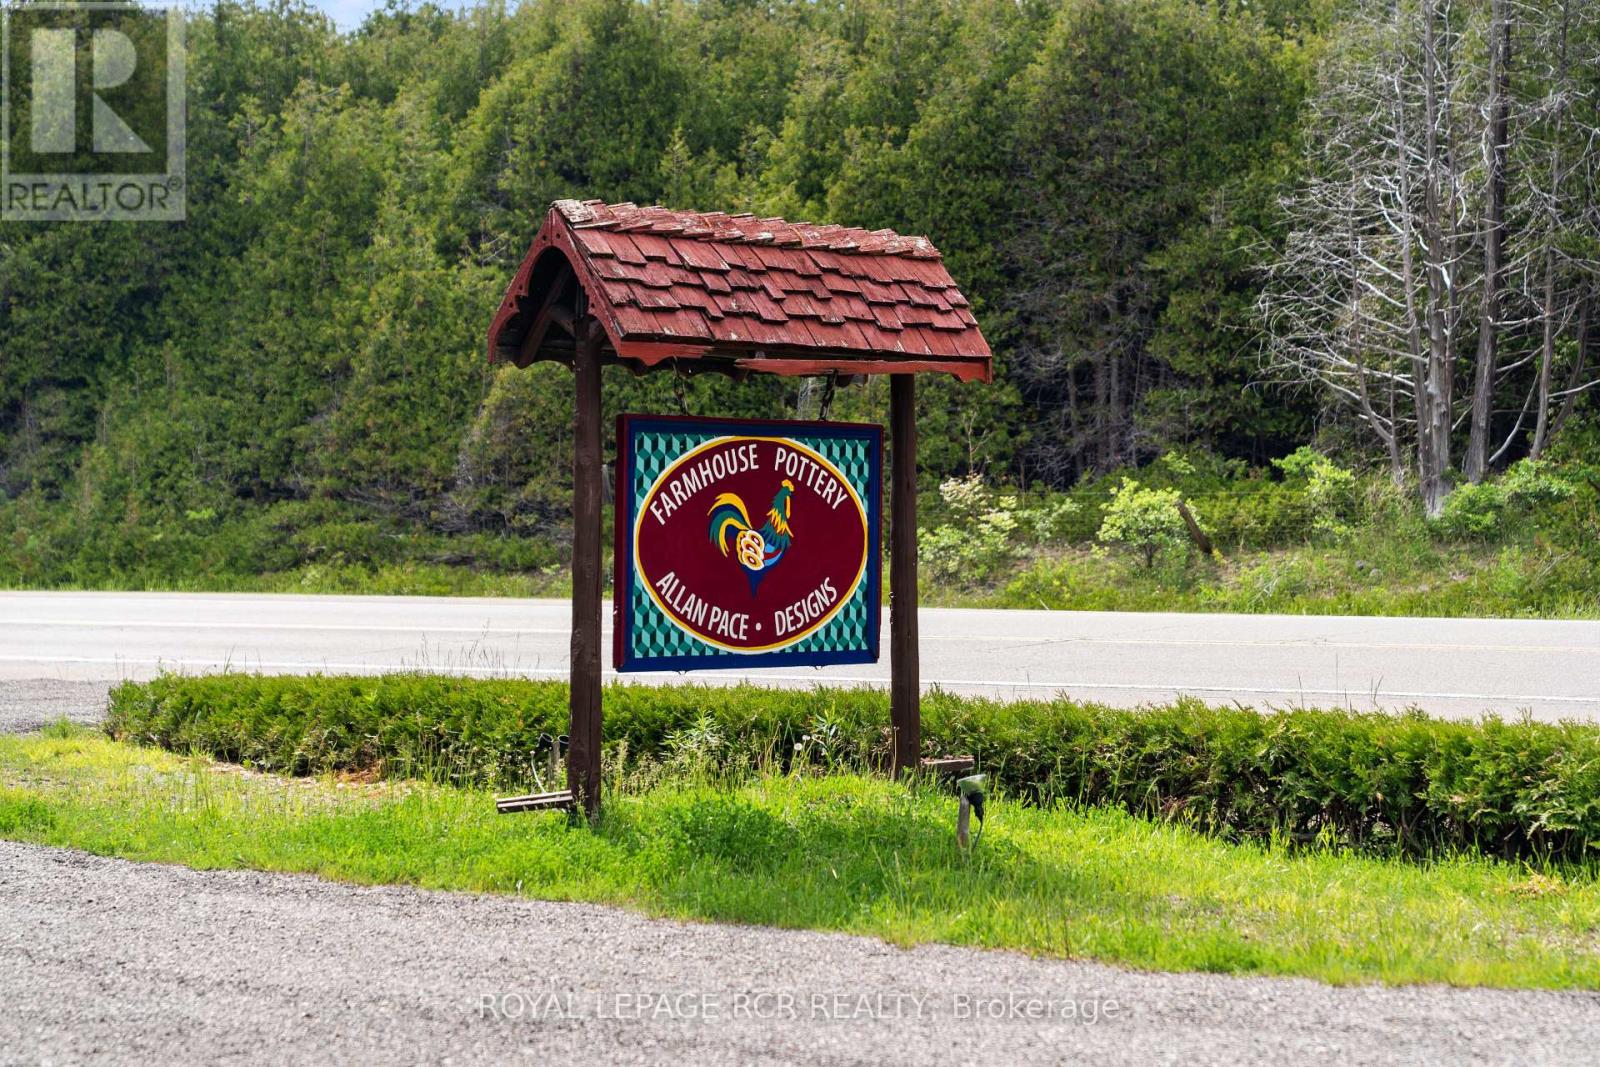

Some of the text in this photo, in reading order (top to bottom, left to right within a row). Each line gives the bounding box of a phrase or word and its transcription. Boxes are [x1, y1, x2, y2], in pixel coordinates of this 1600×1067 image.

[650, 444, 848, 525] FARMHOUSE POTTERY
[656, 571, 838, 640] ALLAN PACE DESIGNS
